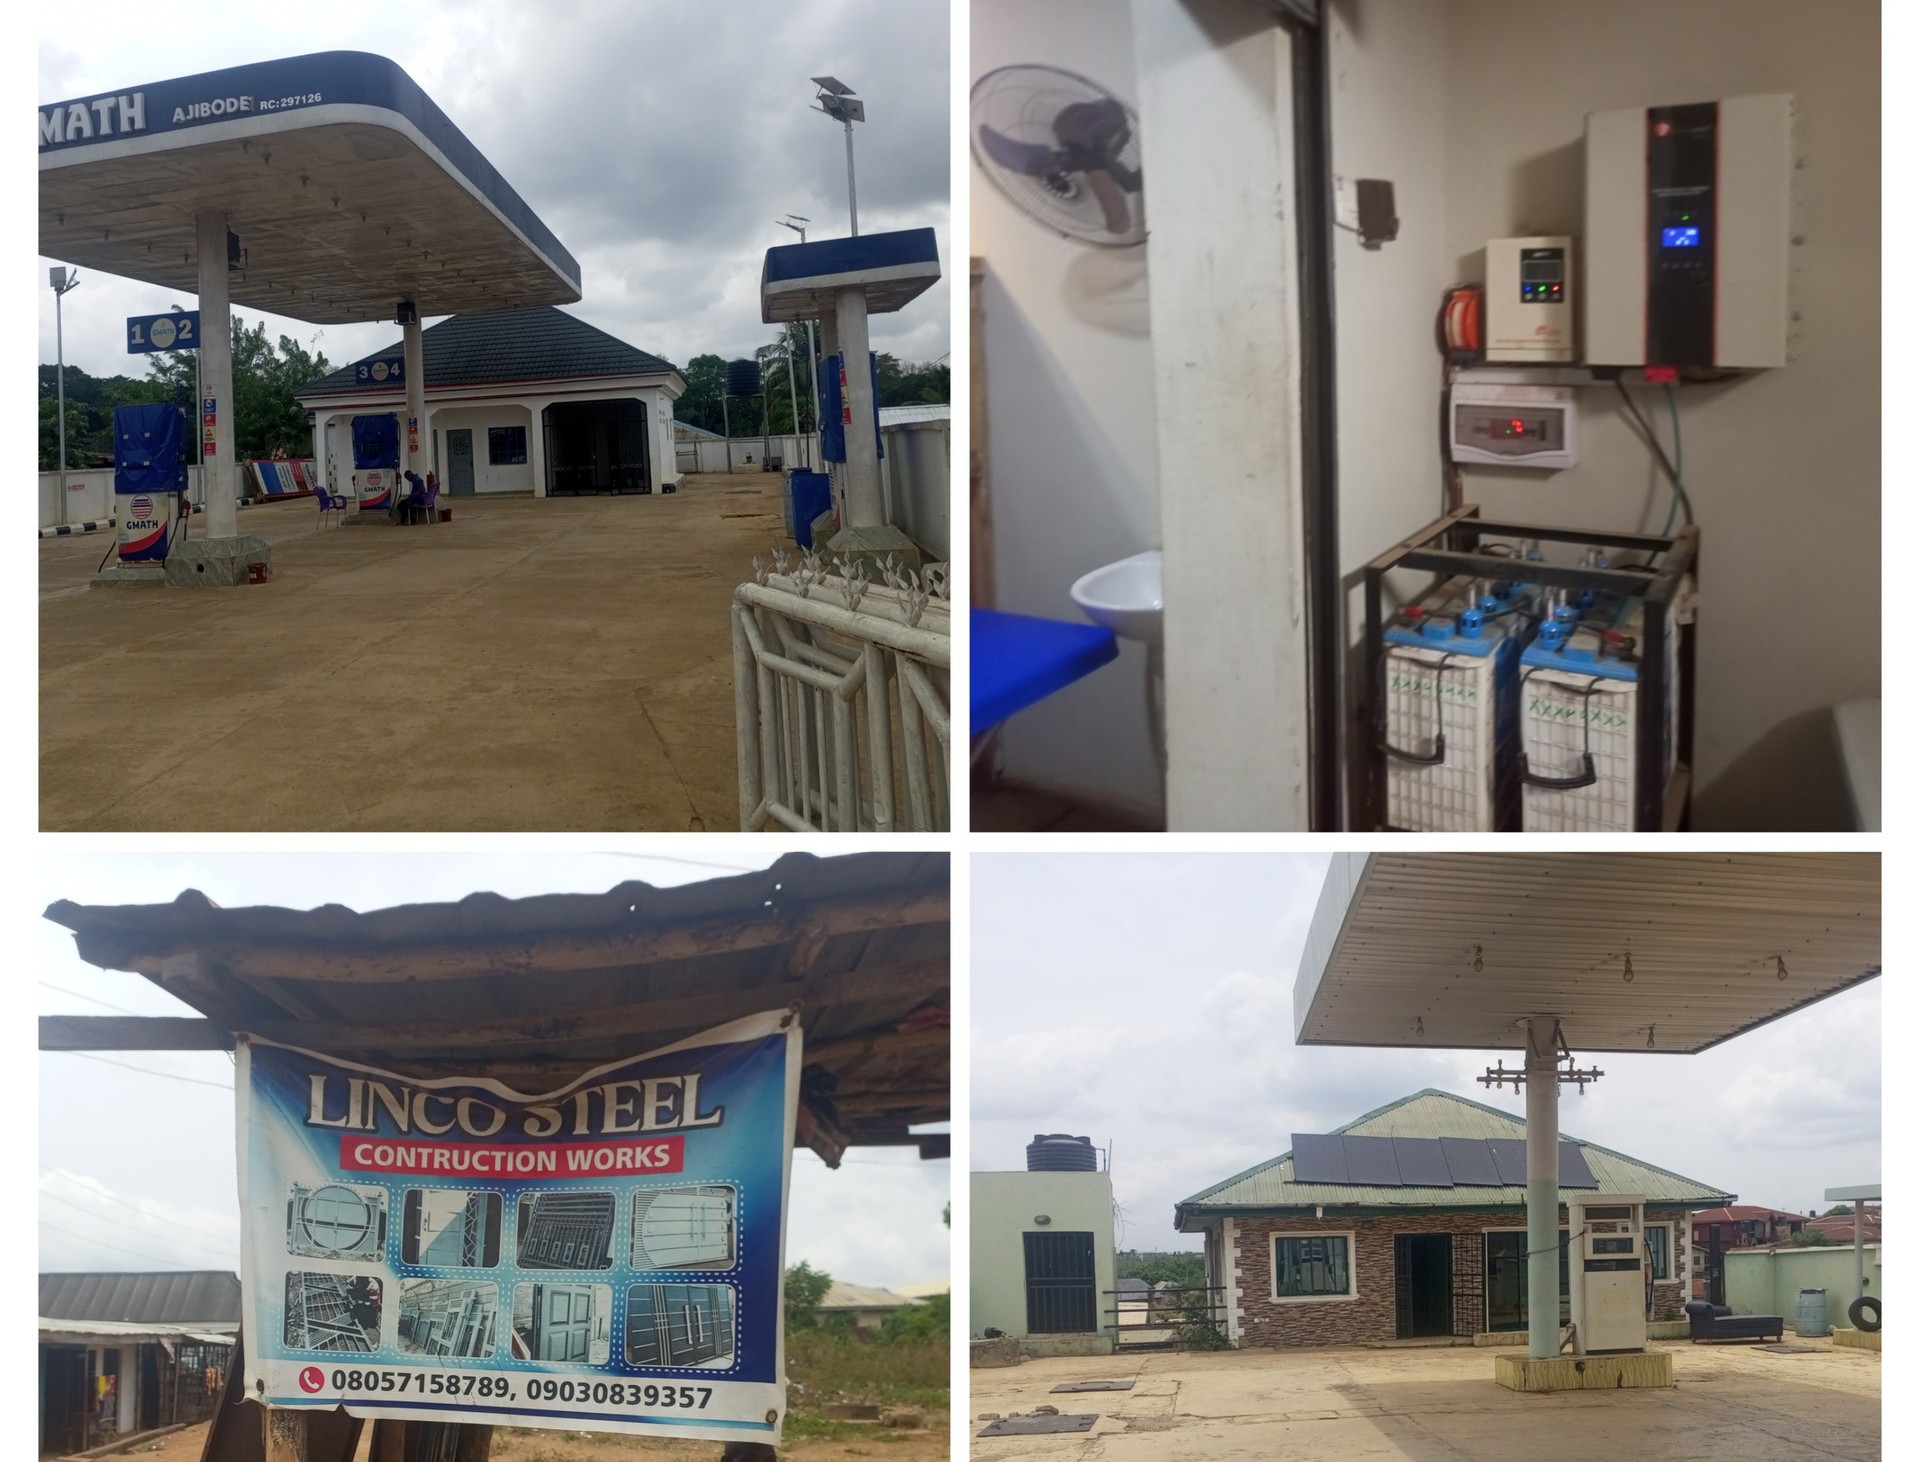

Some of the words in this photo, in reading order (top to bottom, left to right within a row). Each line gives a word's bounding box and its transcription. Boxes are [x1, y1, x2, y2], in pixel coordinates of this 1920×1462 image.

[172, 96, 253, 123] AJIBODE
[260, 92, 322, 111] RC:297126
[131, 323, 145, 345] 1
[178, 319, 193, 340] 2
[359, 366, 369, 379] 3
[390, 363, 400, 376] 4
[126, 520, 159, 530] GMATH
[306, 1073, 507, 1137] LINCO
[522, 1073, 722, 1137] STEEL
[354, 1143, 557, 1172] CONTRUCTION
[566, 1143, 671, 1170] WORKS
[331, 1369, 517, 1402] 08057158789,
[526, 1379, 714, 1410] 09030839357
